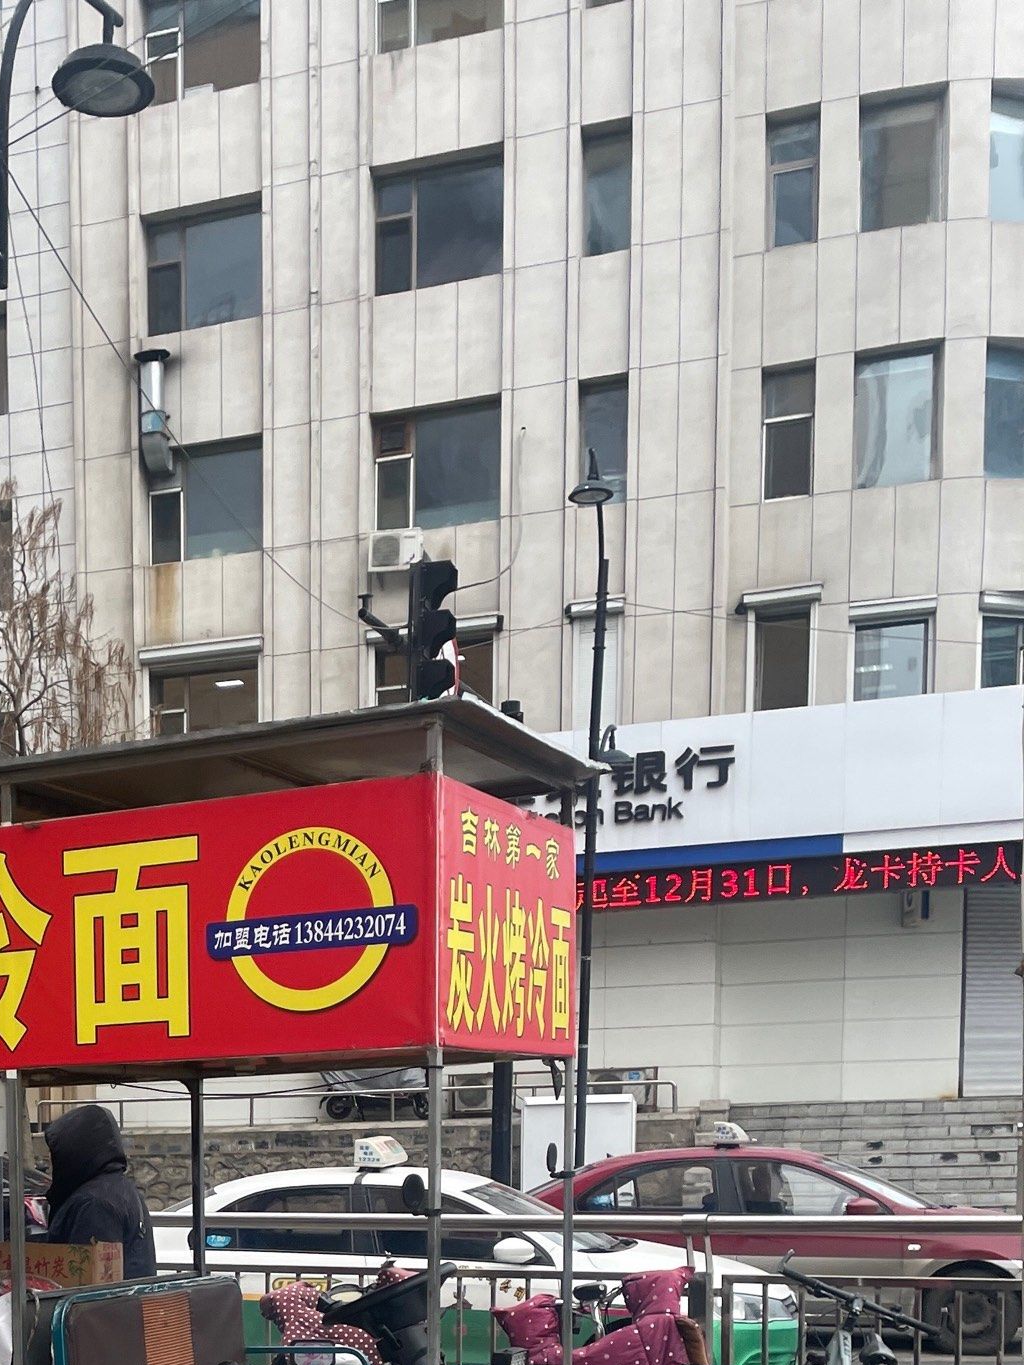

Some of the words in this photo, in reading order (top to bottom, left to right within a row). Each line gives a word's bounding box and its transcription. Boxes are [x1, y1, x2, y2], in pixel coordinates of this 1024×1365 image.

[546, 745, 736, 803] 银行
[614, 797, 684, 824] Bank
[237, 831, 382, 892] KAOLENGMIAN
[461, 806, 560, 880] 吉林第一家
[214, 923, 292, 950] 加盟电话
[294, 912, 406, 945] 13844232074
[445, 872, 571, 1040] 炭火烤冷面
